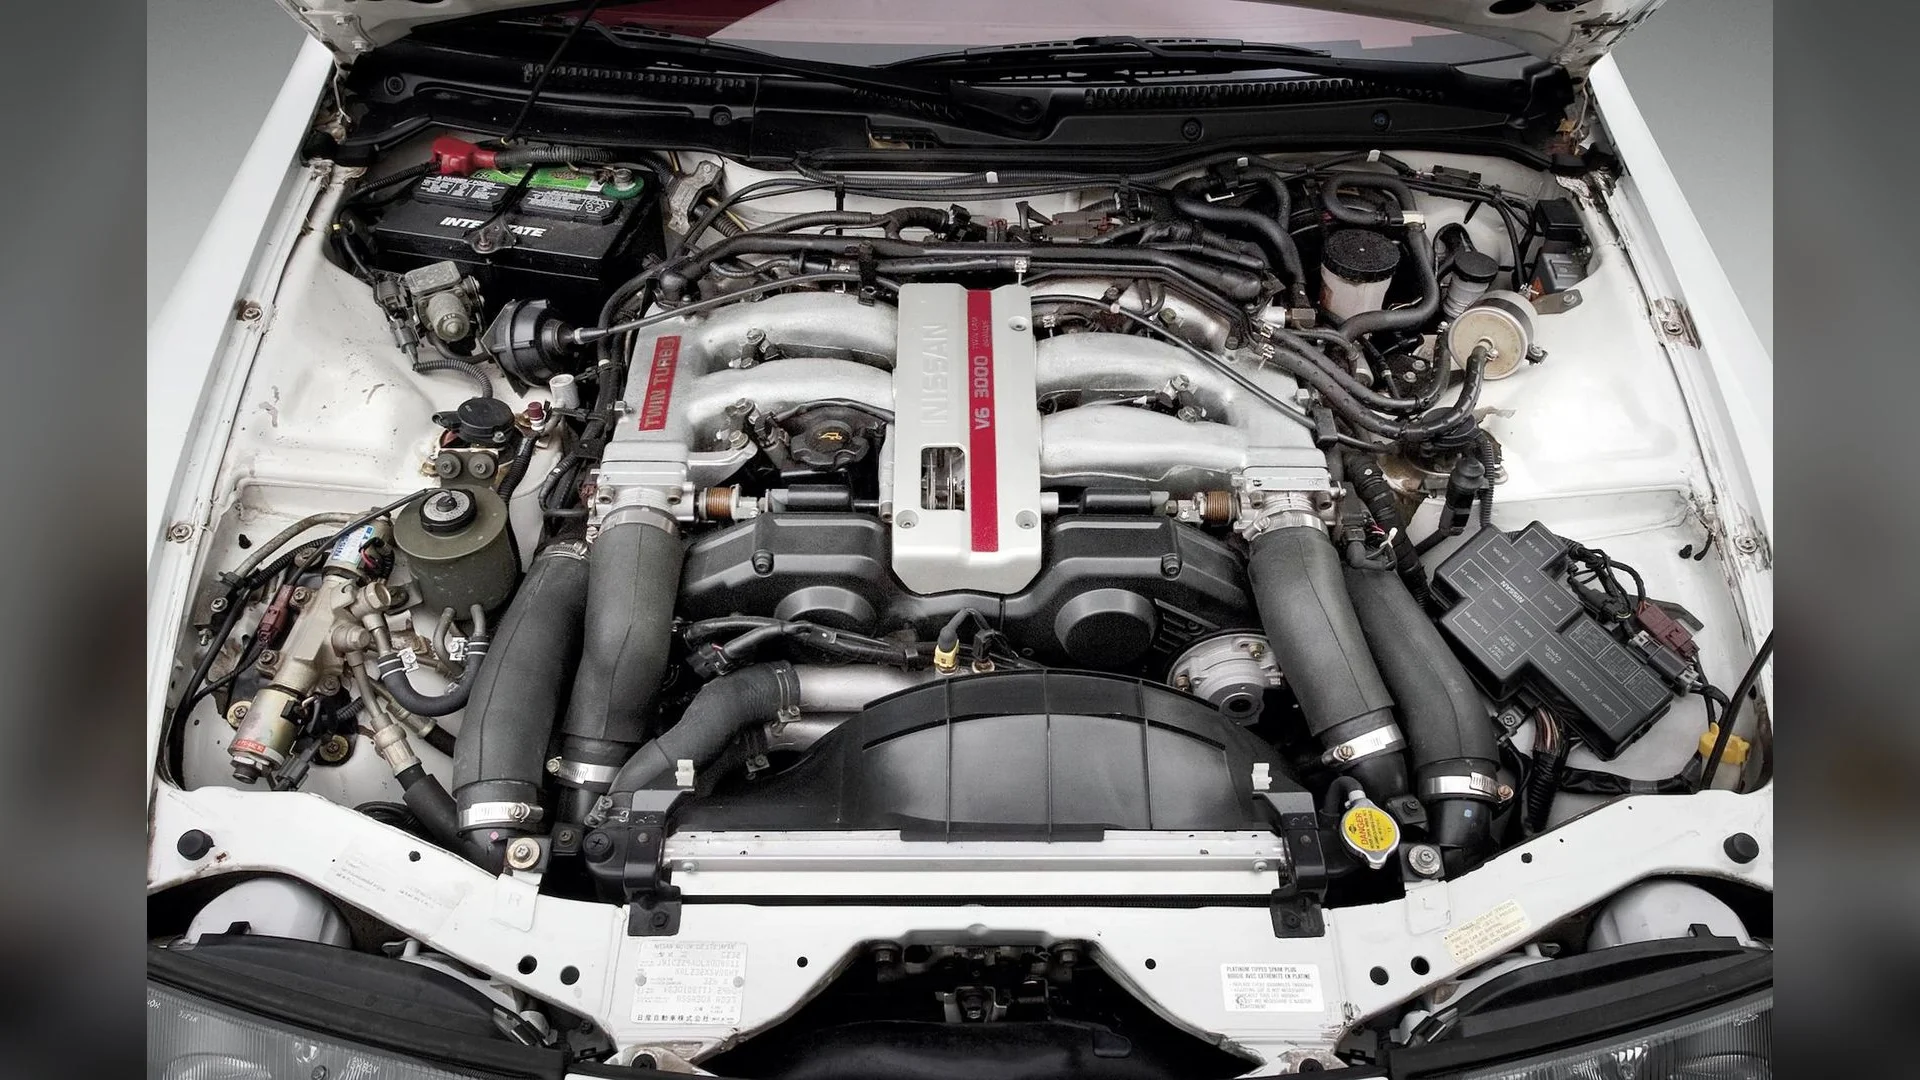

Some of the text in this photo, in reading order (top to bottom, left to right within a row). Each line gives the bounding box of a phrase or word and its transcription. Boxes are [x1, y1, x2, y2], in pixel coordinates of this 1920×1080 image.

[644, 339, 675, 427] TWIN TURBO
[920, 325, 948, 426] NISSAN
[974, 355, 990, 430] V6 3000
[1500, 579, 1525, 605] NISSAN
[1355, 812, 1369, 845] DANGER
